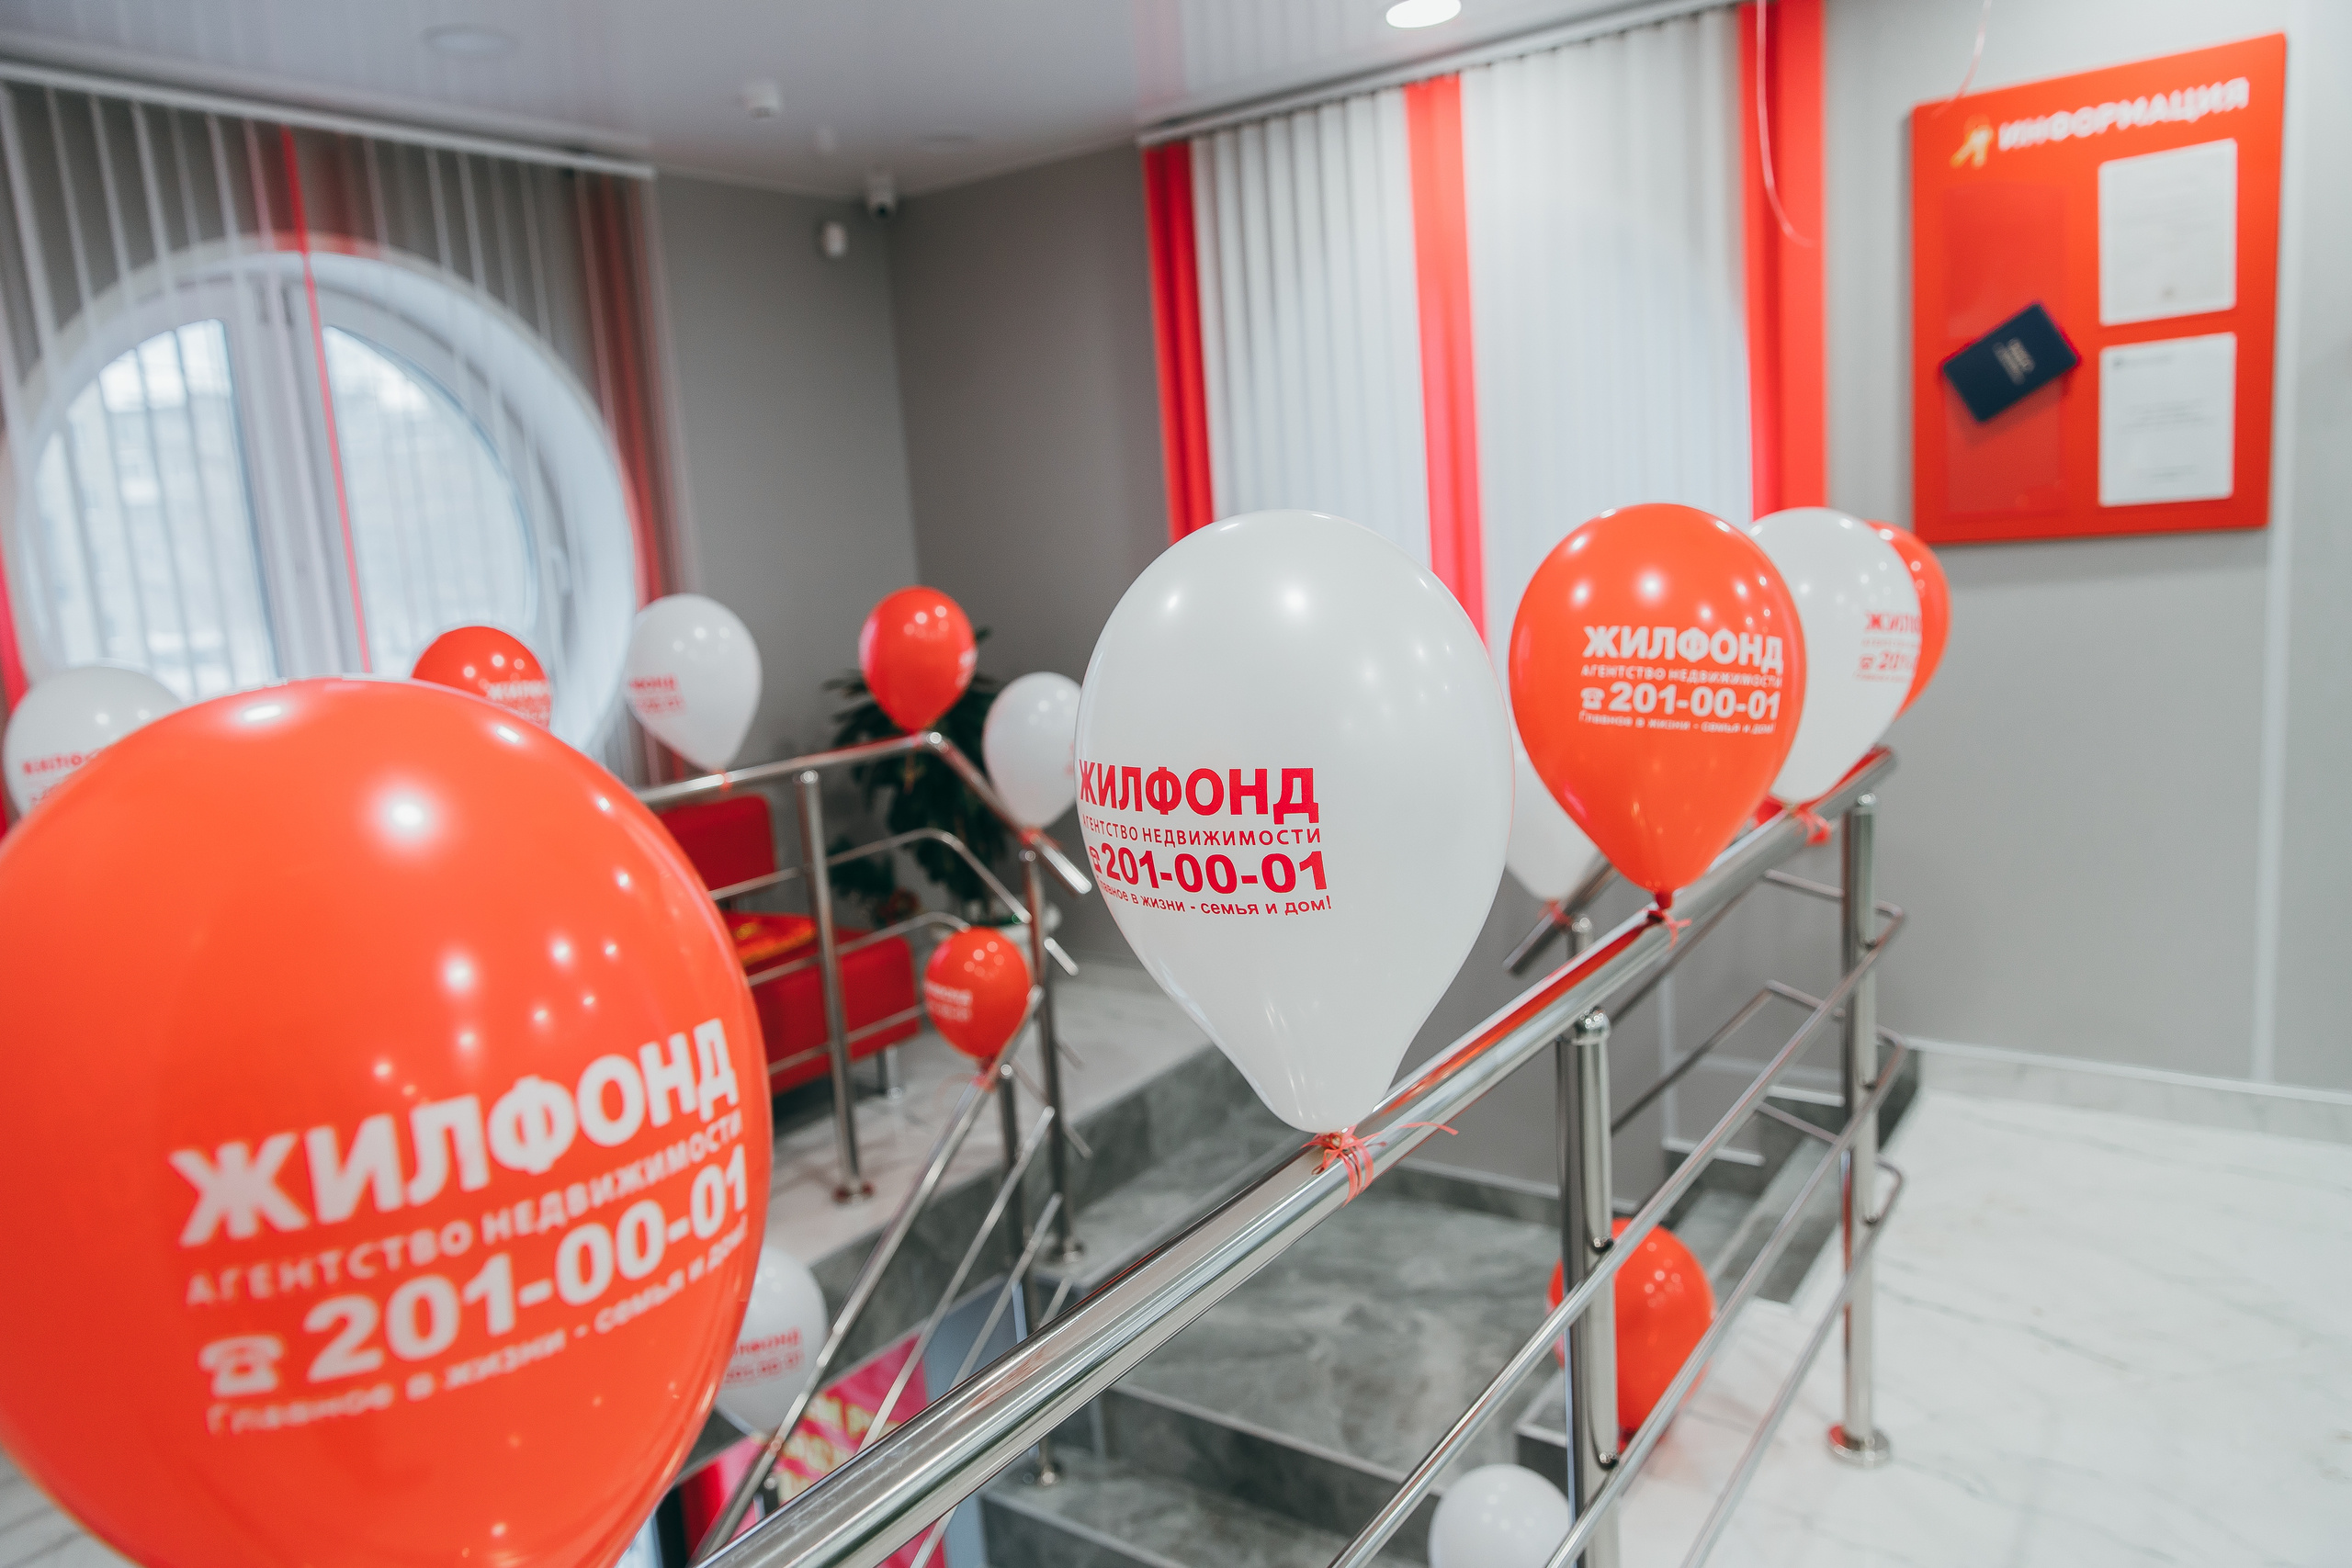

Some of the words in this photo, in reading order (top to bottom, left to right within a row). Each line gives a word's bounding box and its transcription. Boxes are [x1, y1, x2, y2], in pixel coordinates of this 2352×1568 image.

[1998, 76, 2250, 152] ИНФОРМАЦИЯ
[1580, 664, 1667, 681] АГЕНТСТВО
[1668, 669, 1783, 688] НЕДВИЖИМОСТИ
[1582, 625, 1784, 675] ЖИЛФОНД
[1608, 681, 1781, 720] 201-00-01
[1079, 759, 1319, 825] ЖИЛФОНД
[1082, 814, 1138, 841] АГЕНТСТВО
[1142, 828, 1320, 848] НЕДВИЖИМОСТИ
[1101, 842, 1328, 894] 201-00-01
[1140, 896, 1186, 913] жизни
[1200, 901, 1259, 915] семья
[1266, 902, 1278, 914] и
[1284, 896, 1331, 916] дом!
[168, 1017, 739, 1247] ЖИЛФОНД
[187, 1221, 472, 1308] АГЕНТСТВО
[481, 1109, 743, 1246] НЕДВИЖИМОСТИ
[302, 1144, 747, 1382] 201-00-01
